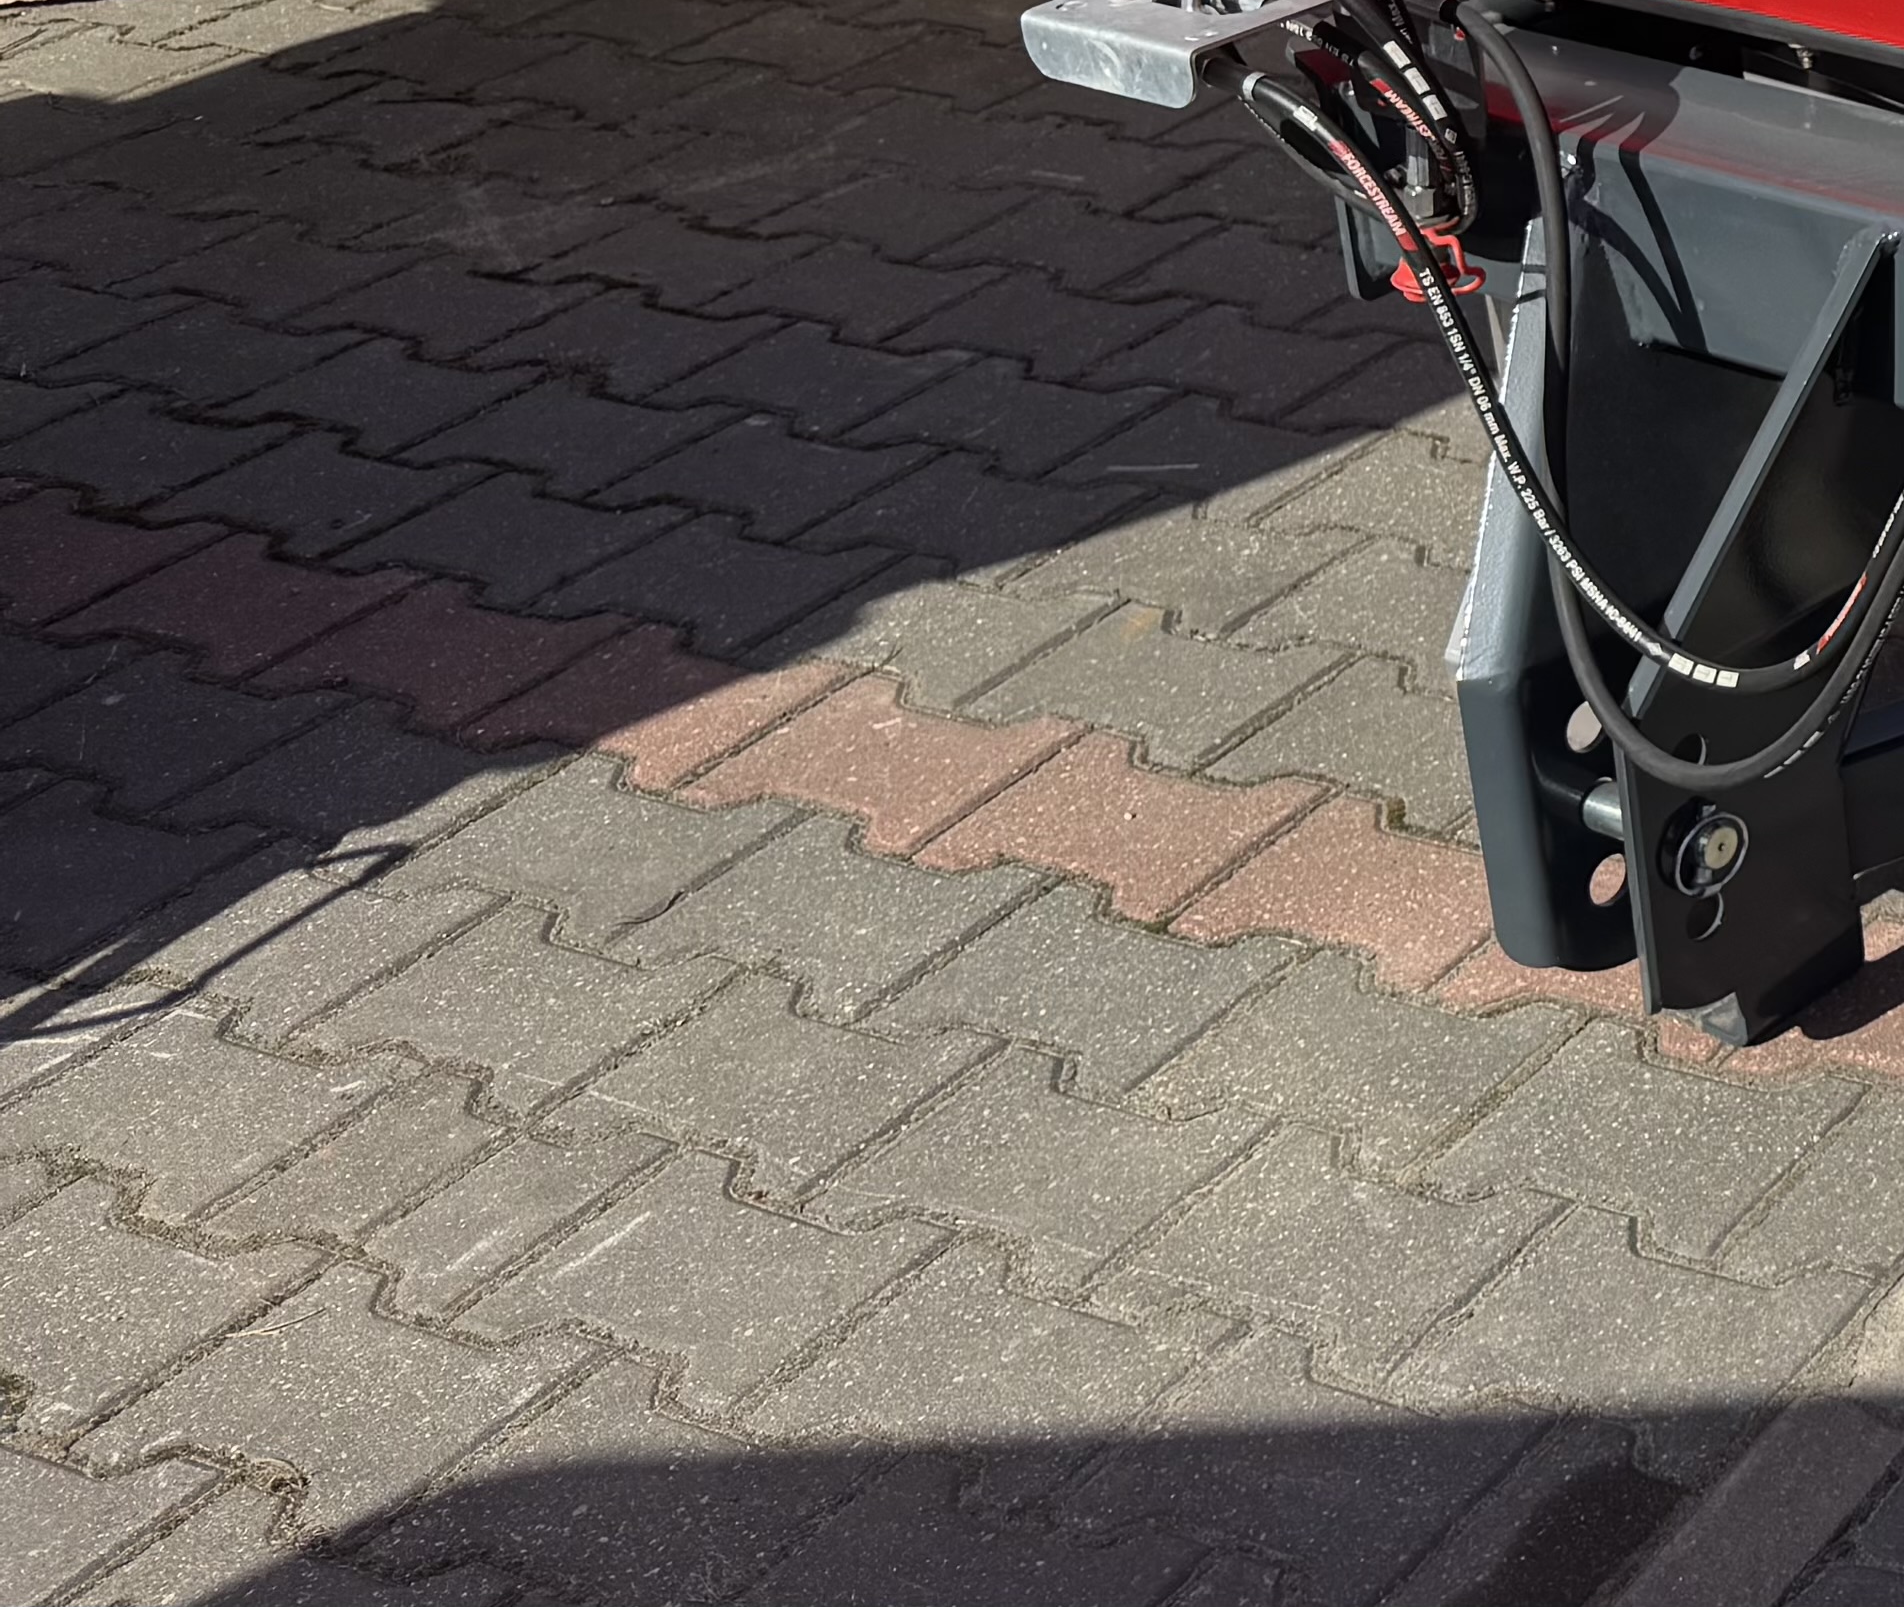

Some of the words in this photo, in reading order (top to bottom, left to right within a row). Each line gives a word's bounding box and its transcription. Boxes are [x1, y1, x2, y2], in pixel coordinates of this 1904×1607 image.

[1342, 152, 1407, 236] FORCESTREAM
[1419, 267, 1434, 287] TS
[1427, 286, 1444, 306] EN
[1436, 305, 1454, 327] 853
[1447, 327, 1466, 353] 1SN
[1468, 375, 1485, 397] DN
[1476, 395, 1491, 413] 06
[1484, 413, 1500, 435] mm
[1494, 434, 1510, 463] Max.
[1507, 461, 1527, 489] W.P.
[1520, 487, 1540, 511] 225
[1532, 508, 1550, 531] Bar
[1549, 534, 1572, 562] 3263
[1565, 559, 1586, 581] PSI
[1579, 577, 1609, 610] MSHA
